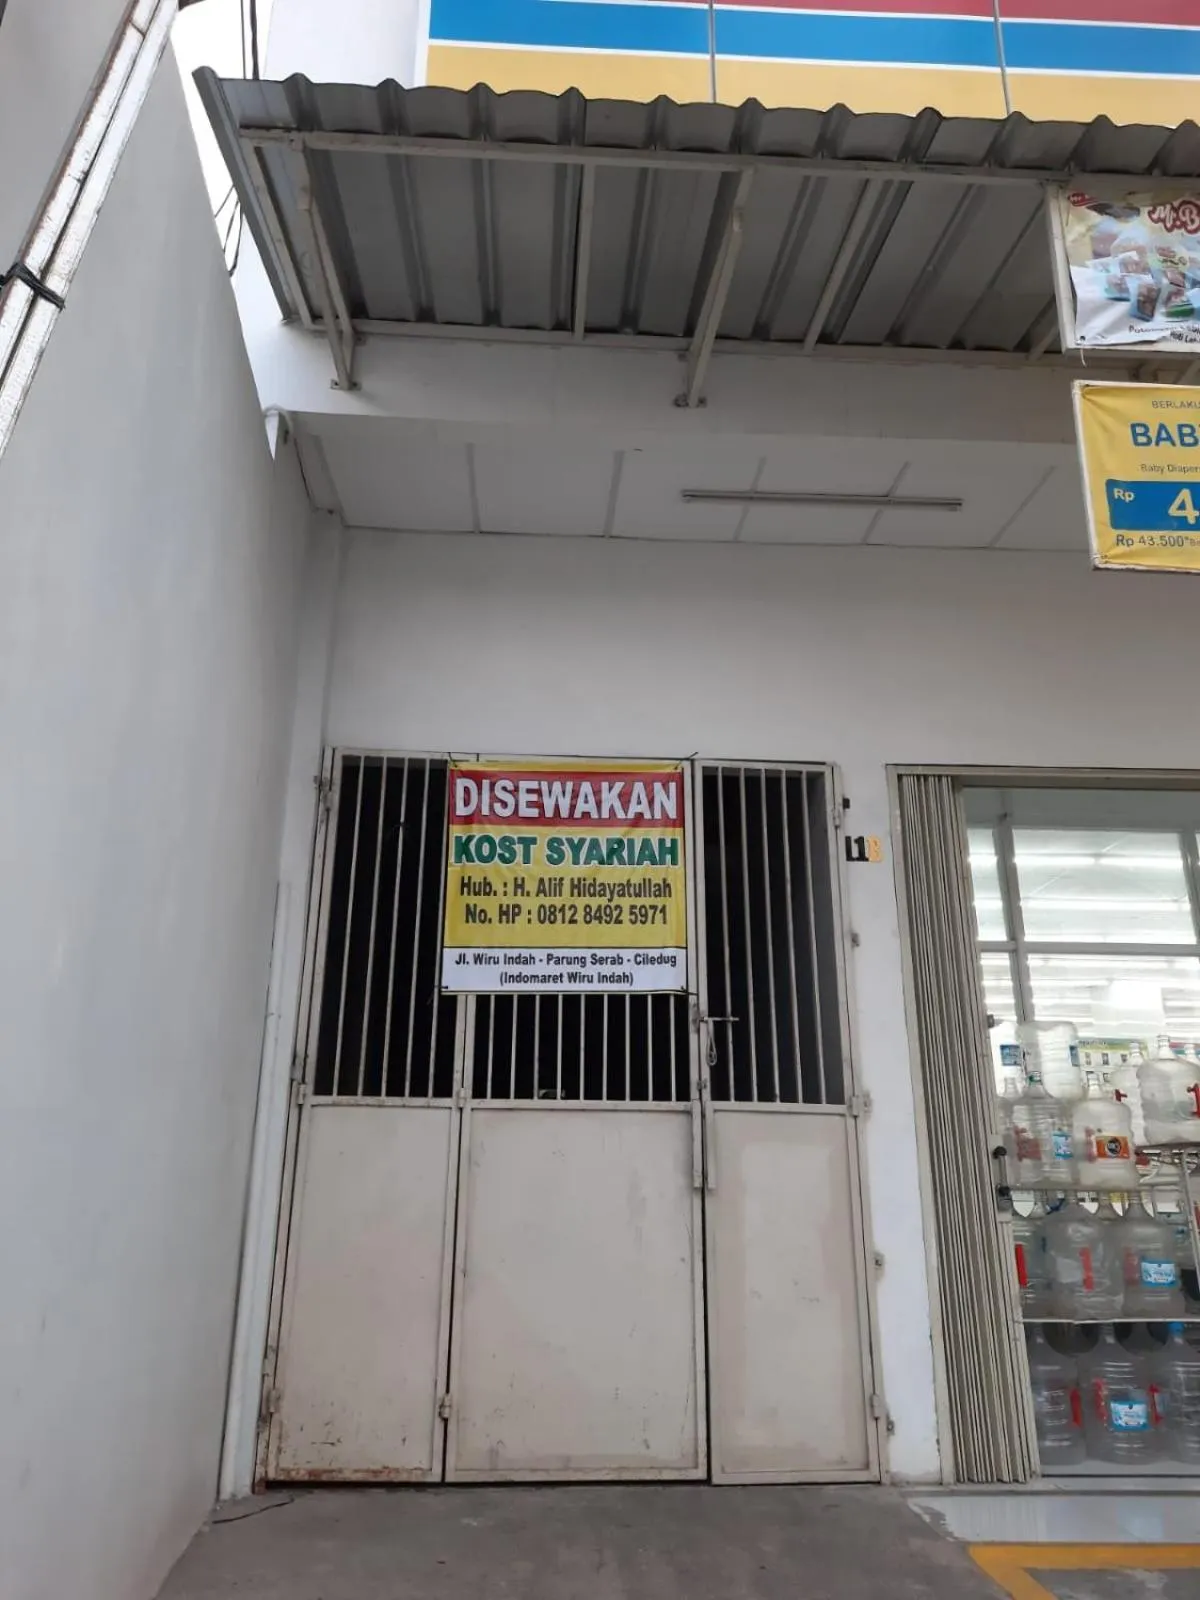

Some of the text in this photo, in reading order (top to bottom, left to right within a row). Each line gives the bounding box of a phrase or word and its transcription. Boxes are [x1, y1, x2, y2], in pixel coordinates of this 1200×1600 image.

[1130, 422, 1200, 447] BAB
[1113, 487, 1200, 525] Rp 4
[1116, 534, 1134, 547] Rp
[455, 777, 678, 820] DISEWAKAN
[453, 835, 680, 867] KOST SYARIAH
[460, 876, 498, 897] Hub.
[513, 877, 531, 897] H.
[536, 876, 564, 898] Alif
[569, 877, 672, 903] Hidayatullah
[465, 904, 493, 924] No.
[499, 904, 522, 924] HP
[537, 904, 578, 924] 0812
[583, 904, 623, 925] 8492
[628, 905, 668, 925] 5971
[455, 953, 470, 966] Jl.
[472, 953, 500, 966] Wiru
[503, 953, 536, 966] Indah
[546, 953, 587, 968] Parung
[590, 953, 624, 966] Serab
[633, 953, 677, 968] Ciledug
[499, 971, 634, 986] (Indomaret Wiru Indah)
